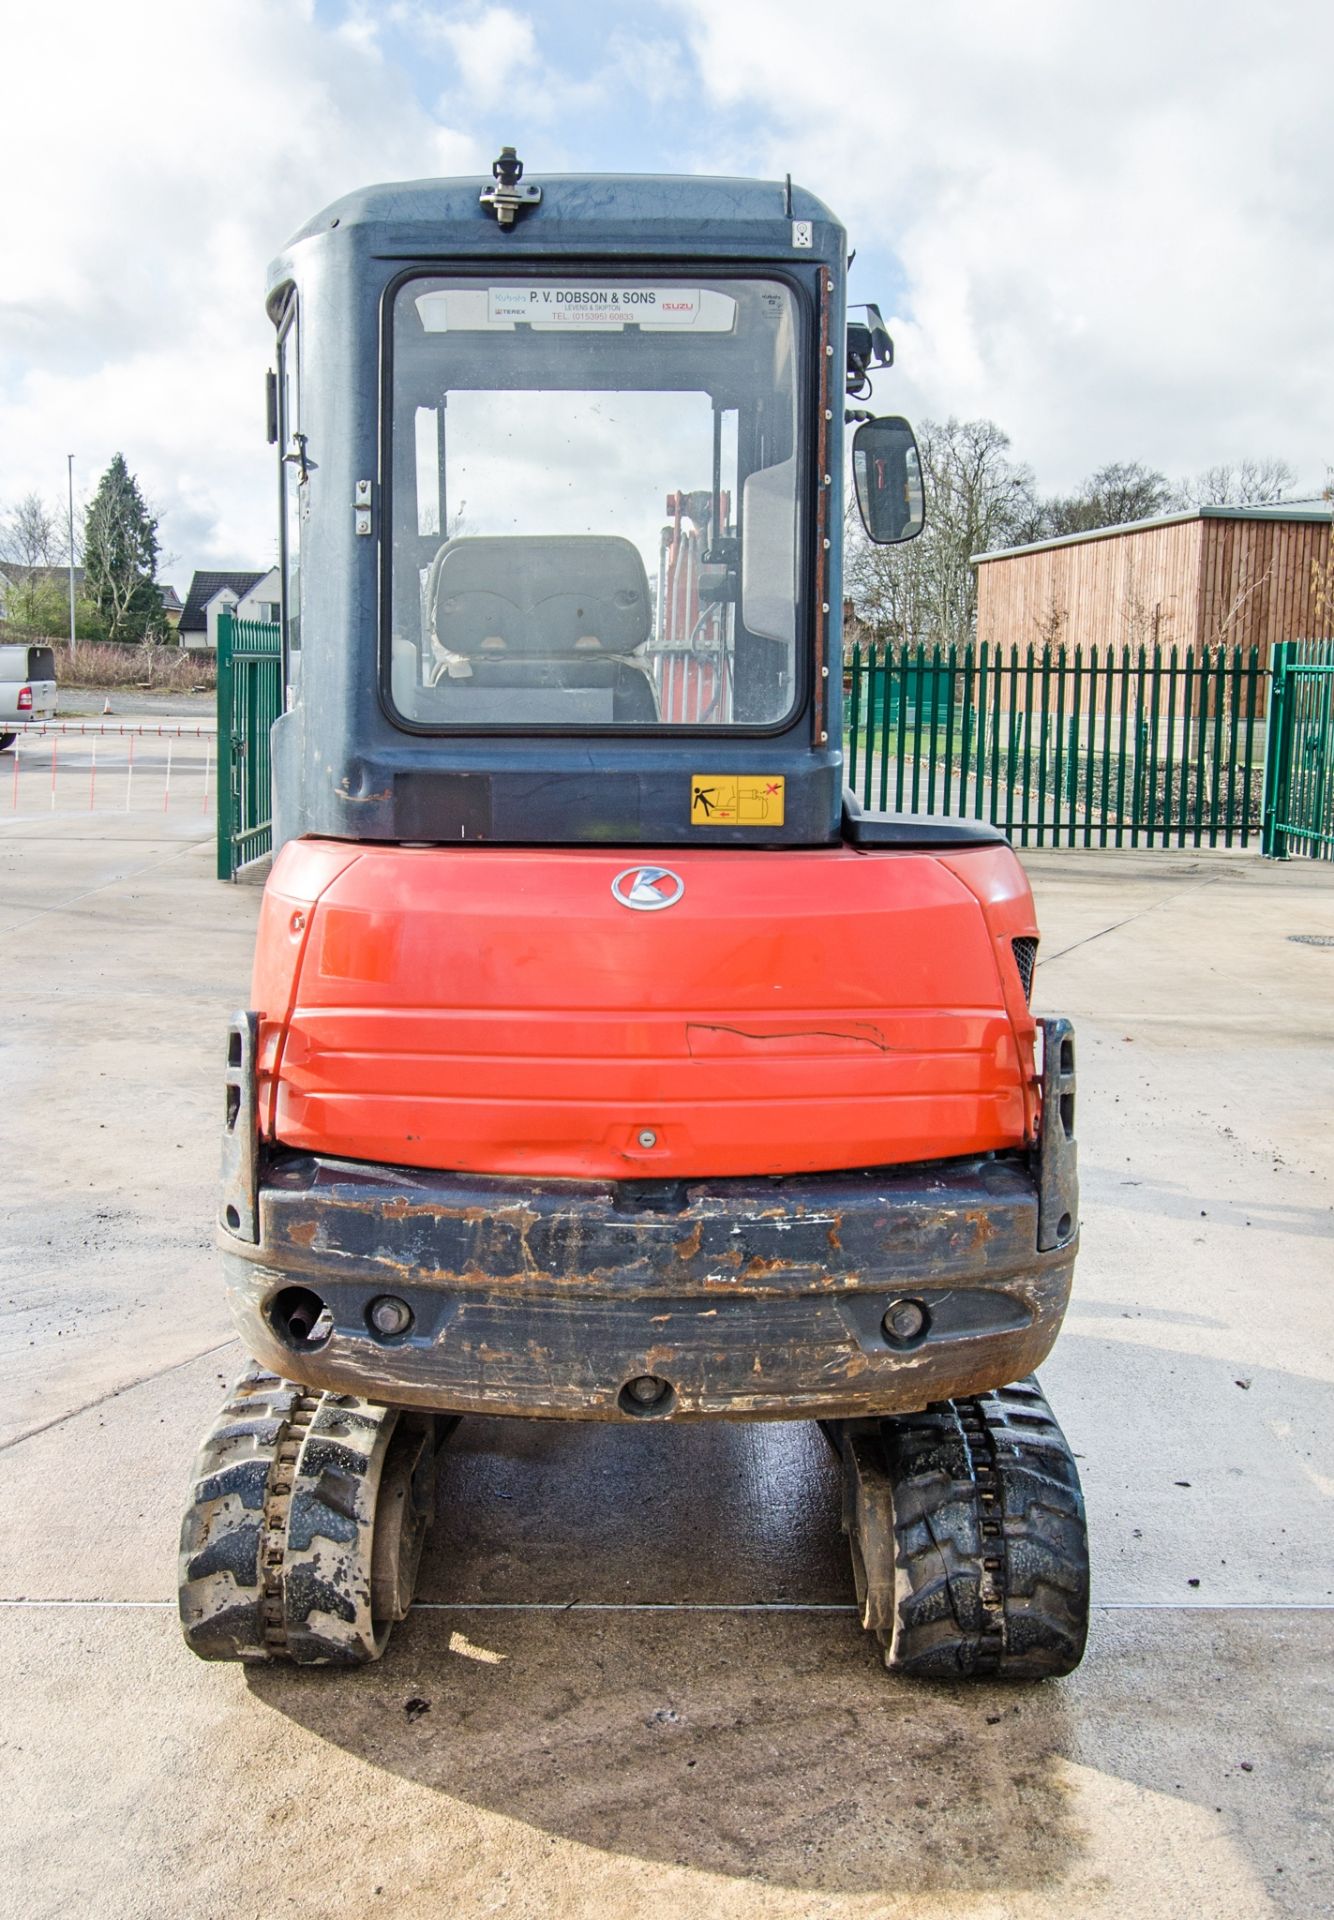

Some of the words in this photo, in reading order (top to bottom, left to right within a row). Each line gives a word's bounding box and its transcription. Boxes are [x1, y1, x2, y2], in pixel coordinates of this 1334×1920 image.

[556, 291, 608, 304] DOBSON
[611, 292, 619, 304] &
[622, 292, 656, 304] SONS
[662, 303, 694, 311] ISUZU
[572, 312, 607, 320] (015395)
